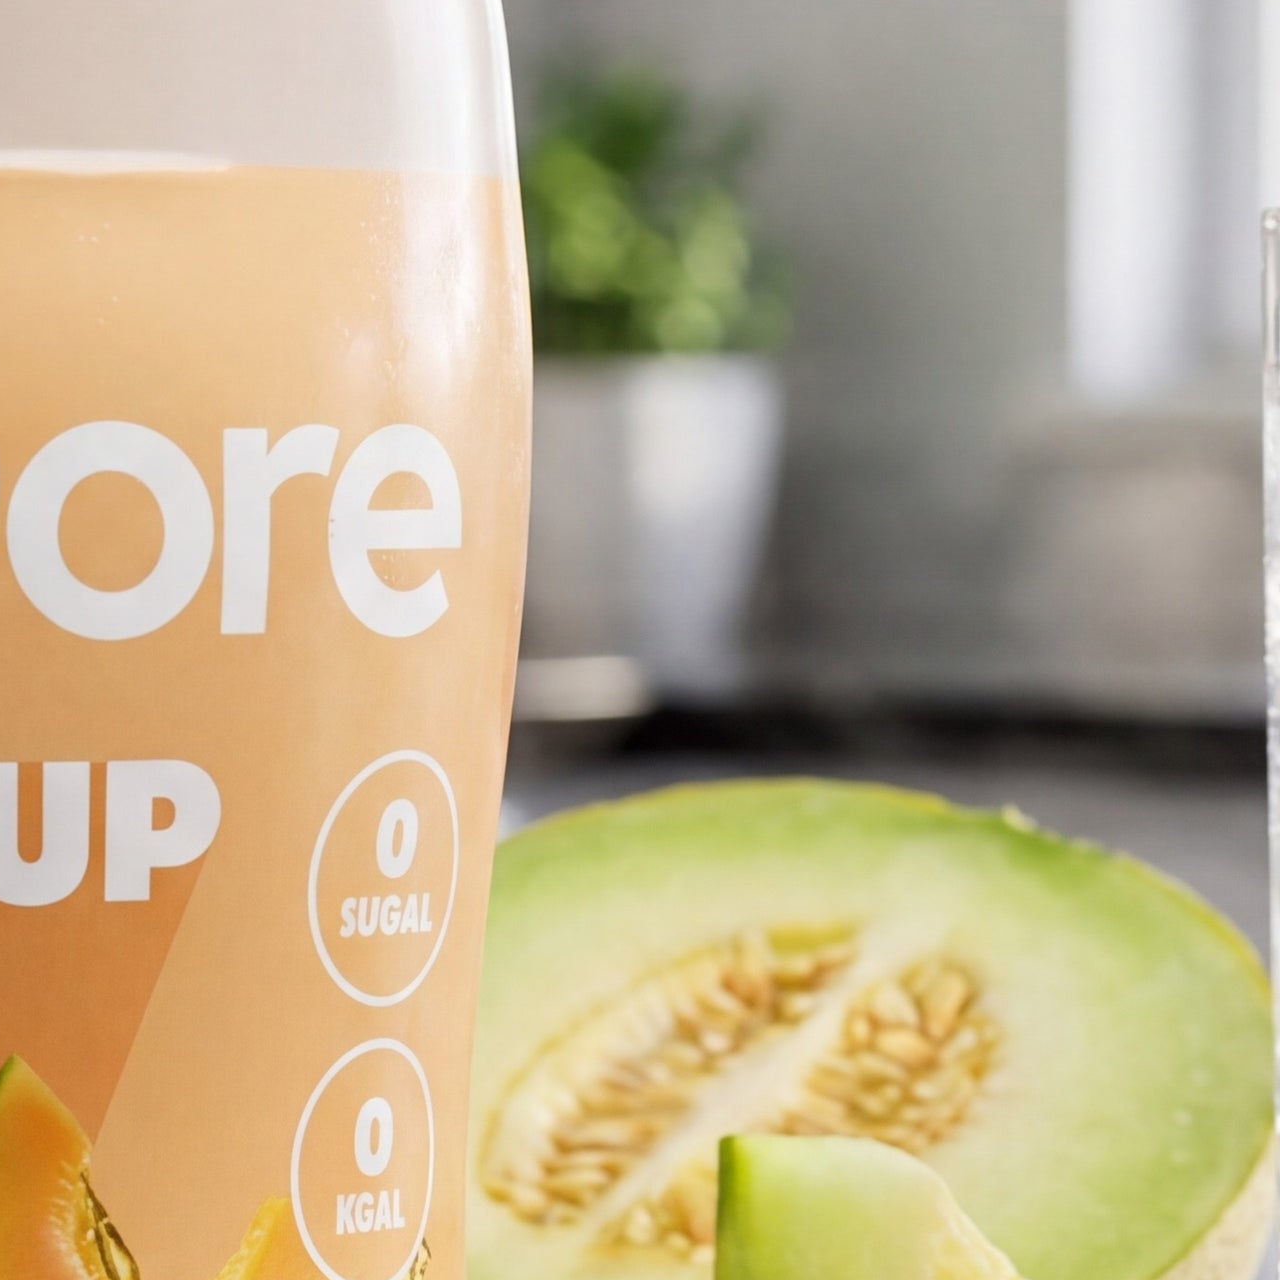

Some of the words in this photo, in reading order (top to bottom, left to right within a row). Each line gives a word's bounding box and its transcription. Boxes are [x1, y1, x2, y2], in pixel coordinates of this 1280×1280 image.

[376, 798, 418, 879] 0
[339, 892, 433, 938] SUGAL
[354, 1096, 394, 1177] 0
[335, 1188, 406, 1235] KGAL
